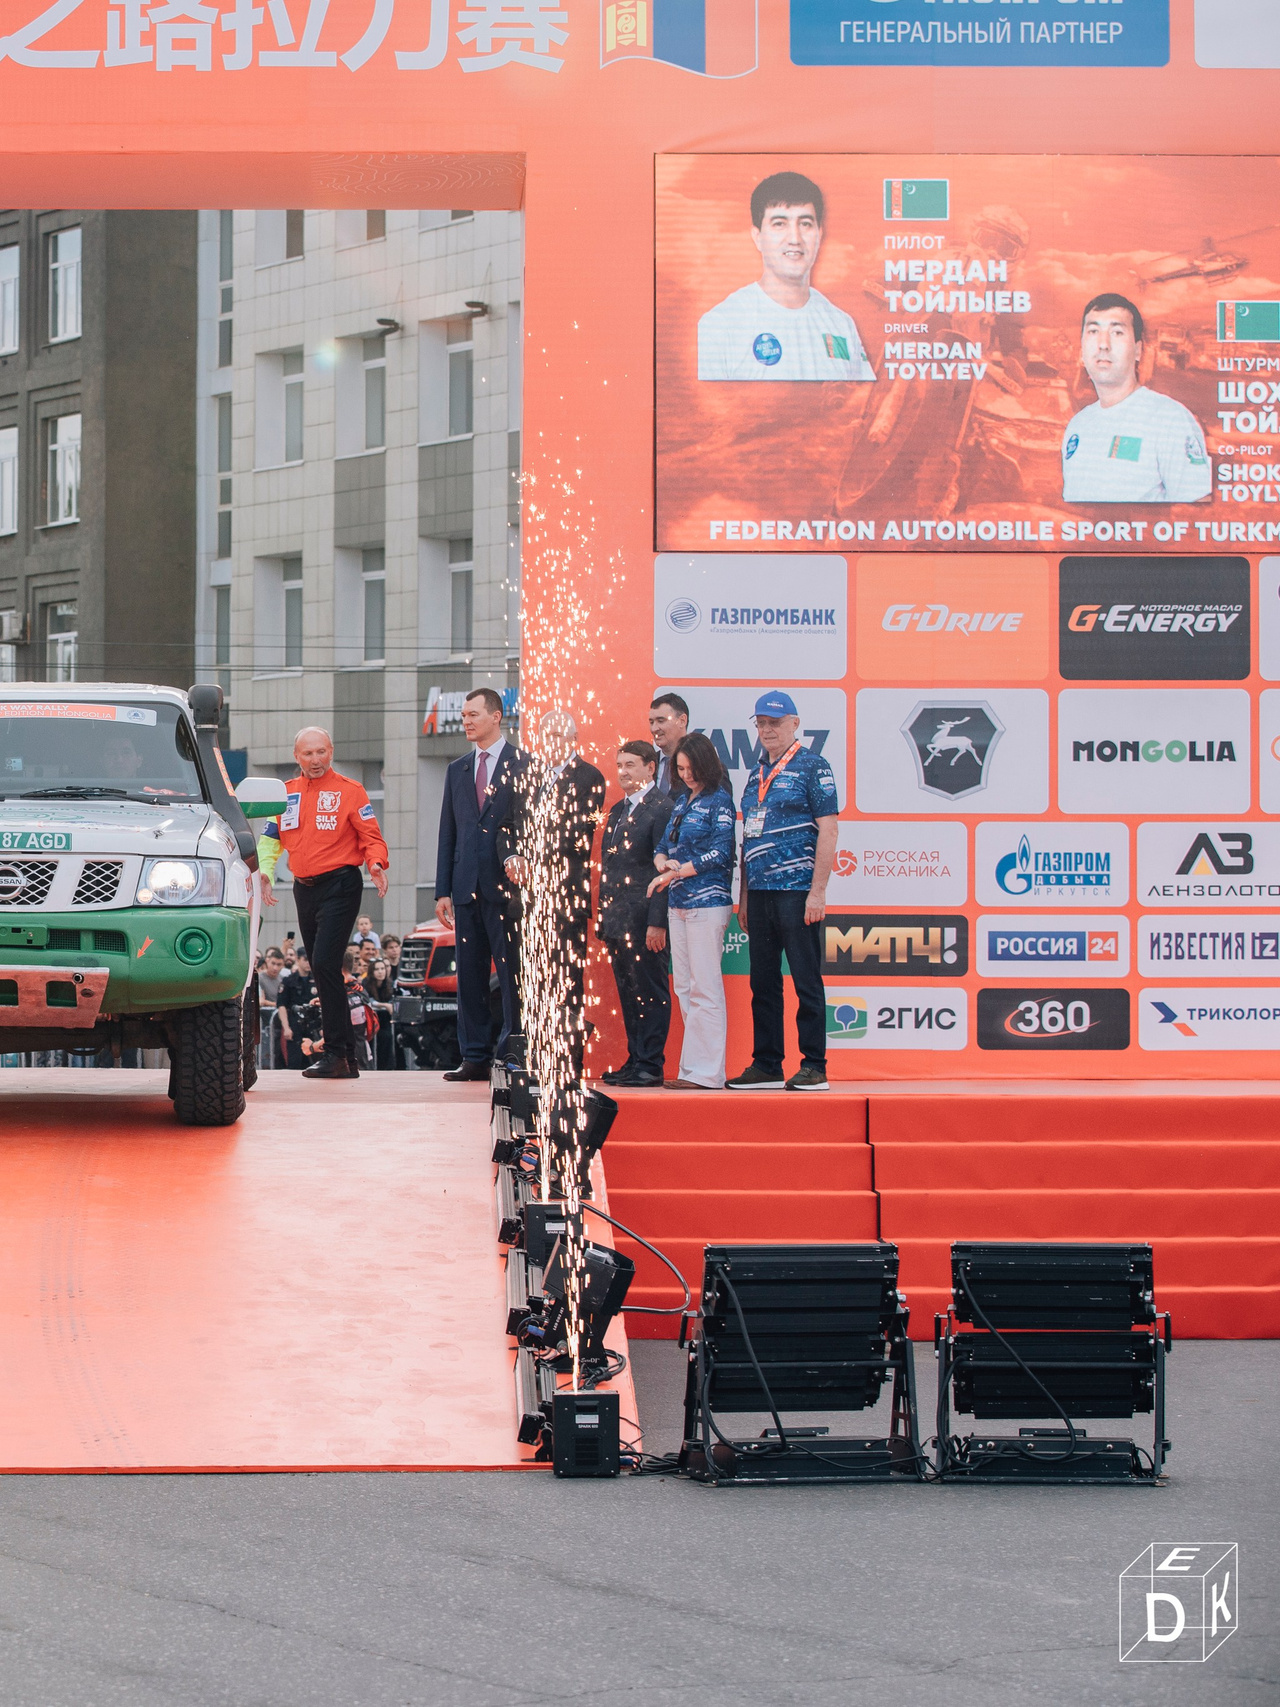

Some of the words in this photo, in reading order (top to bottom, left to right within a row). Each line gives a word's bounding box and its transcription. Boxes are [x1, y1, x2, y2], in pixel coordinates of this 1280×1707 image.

[840, 17, 1011, 43] ГЕНЕРАЛЬНЫЙ
[1020, 22, 1123, 44] ПАРТНЕР
[884, 235, 945, 250] ПИЛОТ
[884, 260, 1008, 285] МЕРДАН
[884, 285, 1032, 313] ТОЙЛЫЕВ
[884, 323, 928, 334] DRIVER
[884, 342, 982, 360] MERDAN
[884, 363, 988, 381] TOYLYEV
[1217, 405, 1280, 433] ТОЙ
[1218, 445, 1273, 456] CO-PILOT
[709, 520, 876, 541] FEDERATION
[883, 520, 1055, 542] AUTOMOBILE
[1061, 521, 1148, 542] SPORT
[1153, 521, 1189, 542] OF
[710, 607, 836, 626] ГАЗПРОМБАНК
[57, 710, 112, 719] MONGOLIA
[1072, 740, 1237, 763] MONGOLIA
[316, 815, 337, 823] SILK
[316, 822, 337, 830] WAY
[2, 832, 22, 848] 87
[26, 832, 67, 849] AGD
[863, 850, 940, 862] РУССКАЯ
[1035, 852, 1111, 872] ГАЗПРОМ
[863, 865, 952, 878] МЕХАНИКА
[1036, 874, 1110, 885] ДОБЫЧА
[1034, 887, 1111, 896] ИРКУТСК
[1147, 884, 1280, 897] ЛЕНЗОЛОТО
[825, 926, 958, 965] МАТЧ!
[996, 937, 1078, 955] РОССИЯ
[1090, 937, 1116, 955] 24
[1150, 932, 1245, 960] ИЗВЕСТИЯ
[877, 1007, 957, 1030] 2ГИС
[1017, 1000, 1091, 1033] 360
[1186, 1008, 1280, 1021] ТРИКОЛОР
